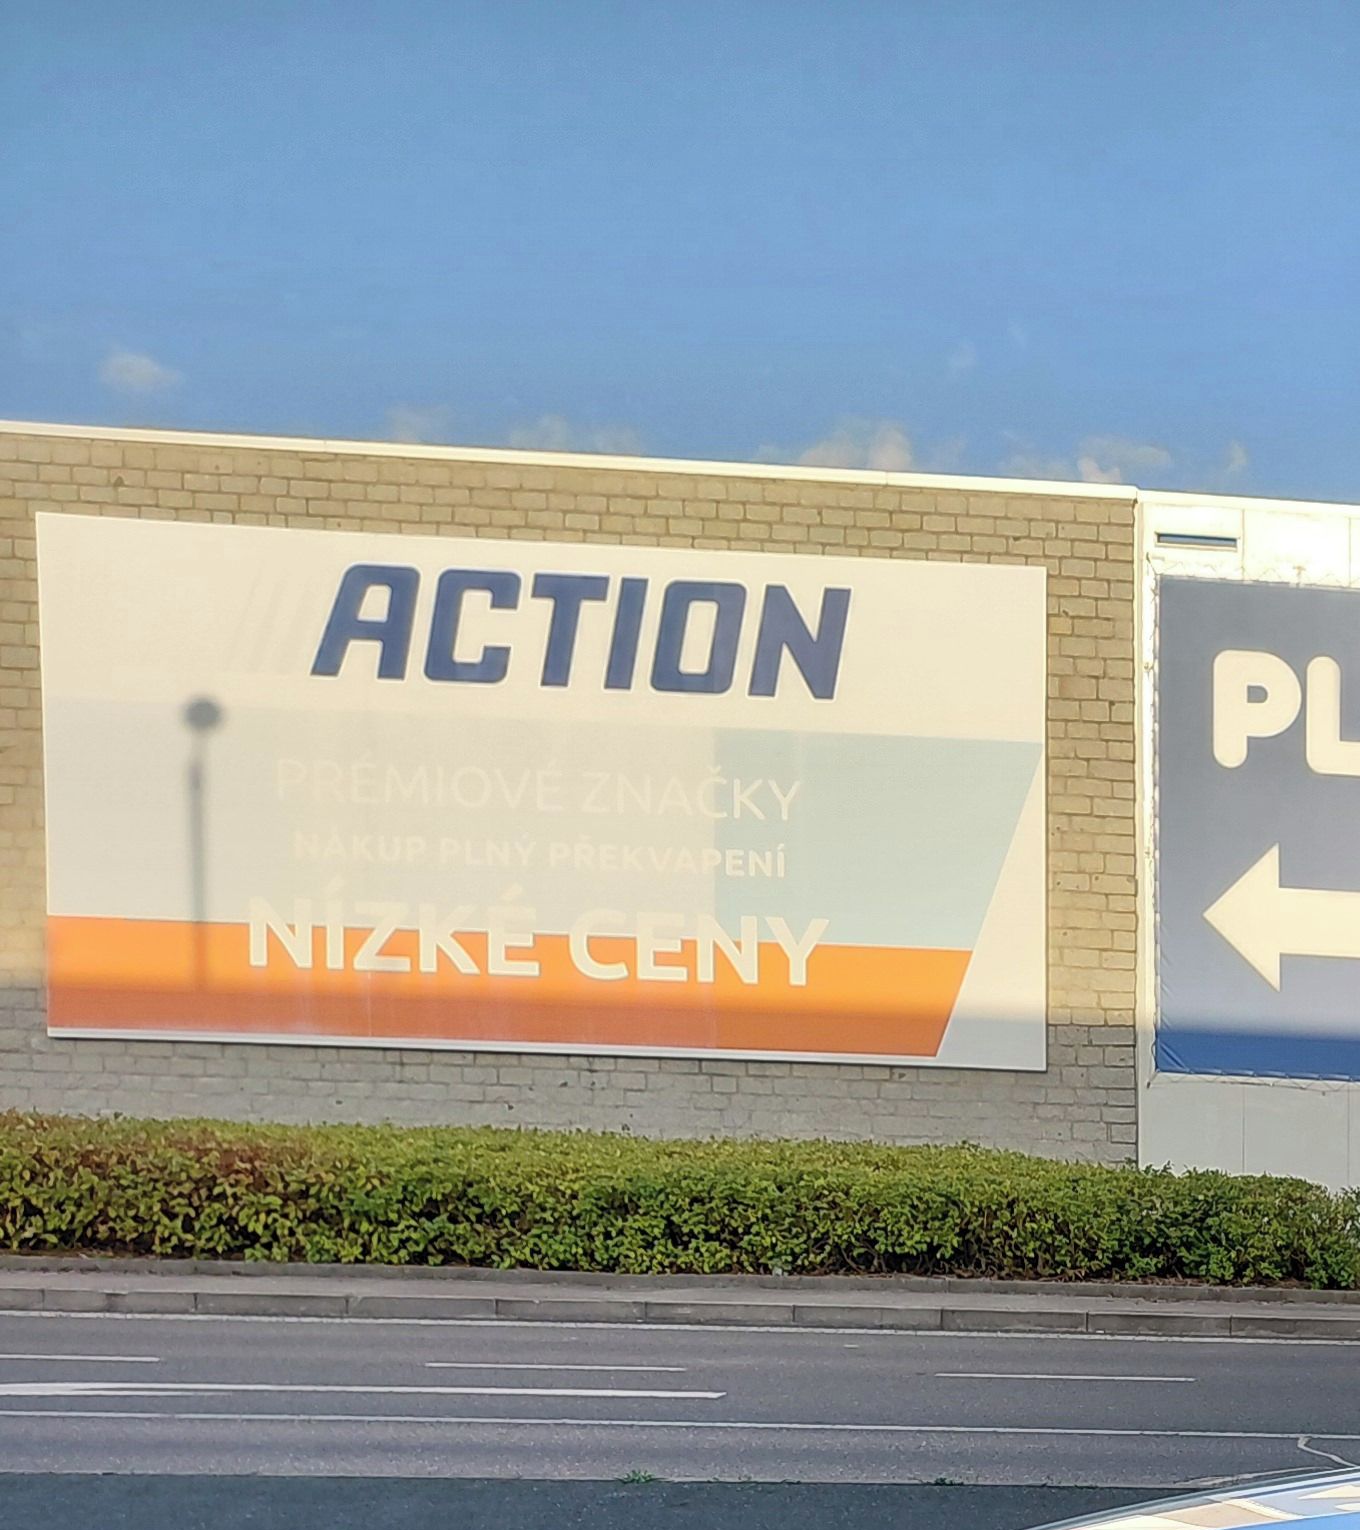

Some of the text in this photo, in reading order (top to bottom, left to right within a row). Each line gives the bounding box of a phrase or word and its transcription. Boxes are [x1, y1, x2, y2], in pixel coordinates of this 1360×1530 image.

[310, 563, 852, 700] ACTION
[275, 754, 801, 821] PRÉMIOVÉ ZNAČKY
[439, 832, 537, 868] PLNÝ
[549, 837, 787, 879] PŘEKVAPENÍ
[249, 874, 830, 987] NÍZKÉ CENY
